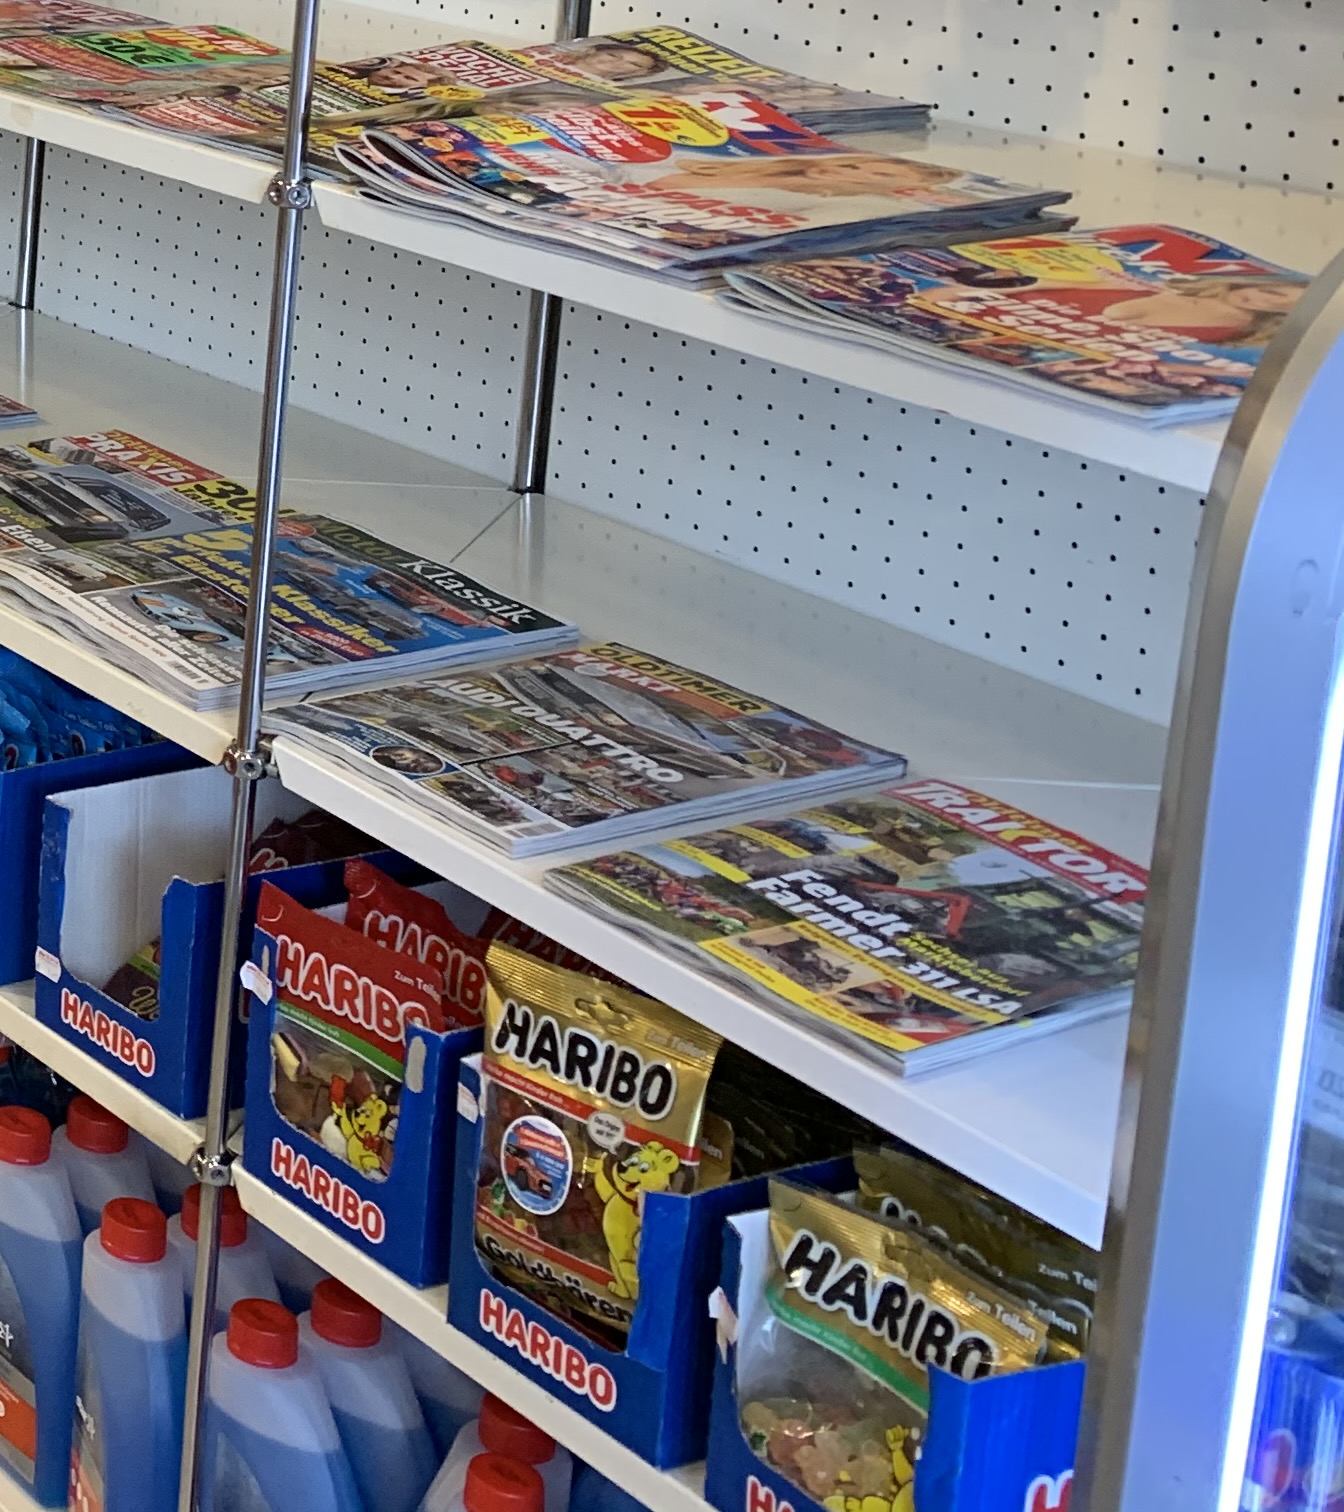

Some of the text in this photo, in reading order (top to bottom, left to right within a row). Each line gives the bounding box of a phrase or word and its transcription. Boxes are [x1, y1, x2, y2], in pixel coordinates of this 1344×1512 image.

[450, 47, 536, 84] WOCHE
[75, 432, 196, 485] PRAXIS
[2, 520, 58, 552] Eisen
[272, 583, 401, 654] Klassiker
[399, 558, 538, 628] Klassik
[589, 644, 764, 714] OLDTIMER
[423, 677, 685, 785] AUDI QUATTRO
[904, 781, 1150, 901] TRAKTOR
[772, 868, 912, 937] Fendt
[393, 970, 414, 986] Zum
[746, 876, 1026, 1017] Farmer 311 LSA
[60, 987, 156, 1078] HARIBO
[492, 1001, 678, 1122] HARIBO
[270, 1136, 386, 1245] HARIBO
[783, 1228, 999, 1381] HARIBO
[994, 1303, 1037, 1342] Teilen
[478, 1286, 618, 1414] HARIBO
